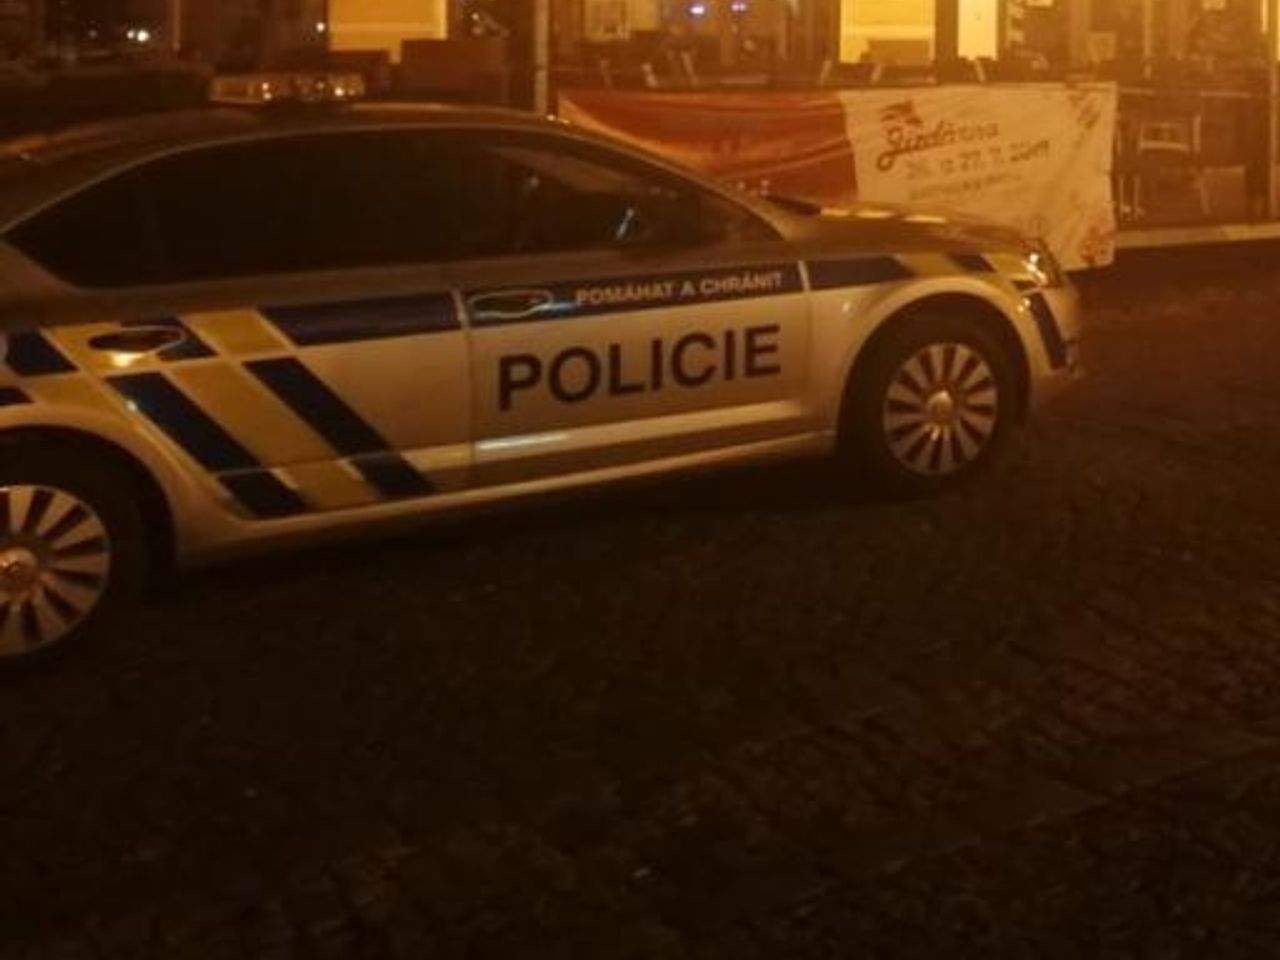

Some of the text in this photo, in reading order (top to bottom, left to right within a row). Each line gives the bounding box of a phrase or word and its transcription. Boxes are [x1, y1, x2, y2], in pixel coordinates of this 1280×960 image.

[576, 270, 782, 306] POMÁHAT A CHRÁNIT
[497, 323, 782, 412] POLICIE
